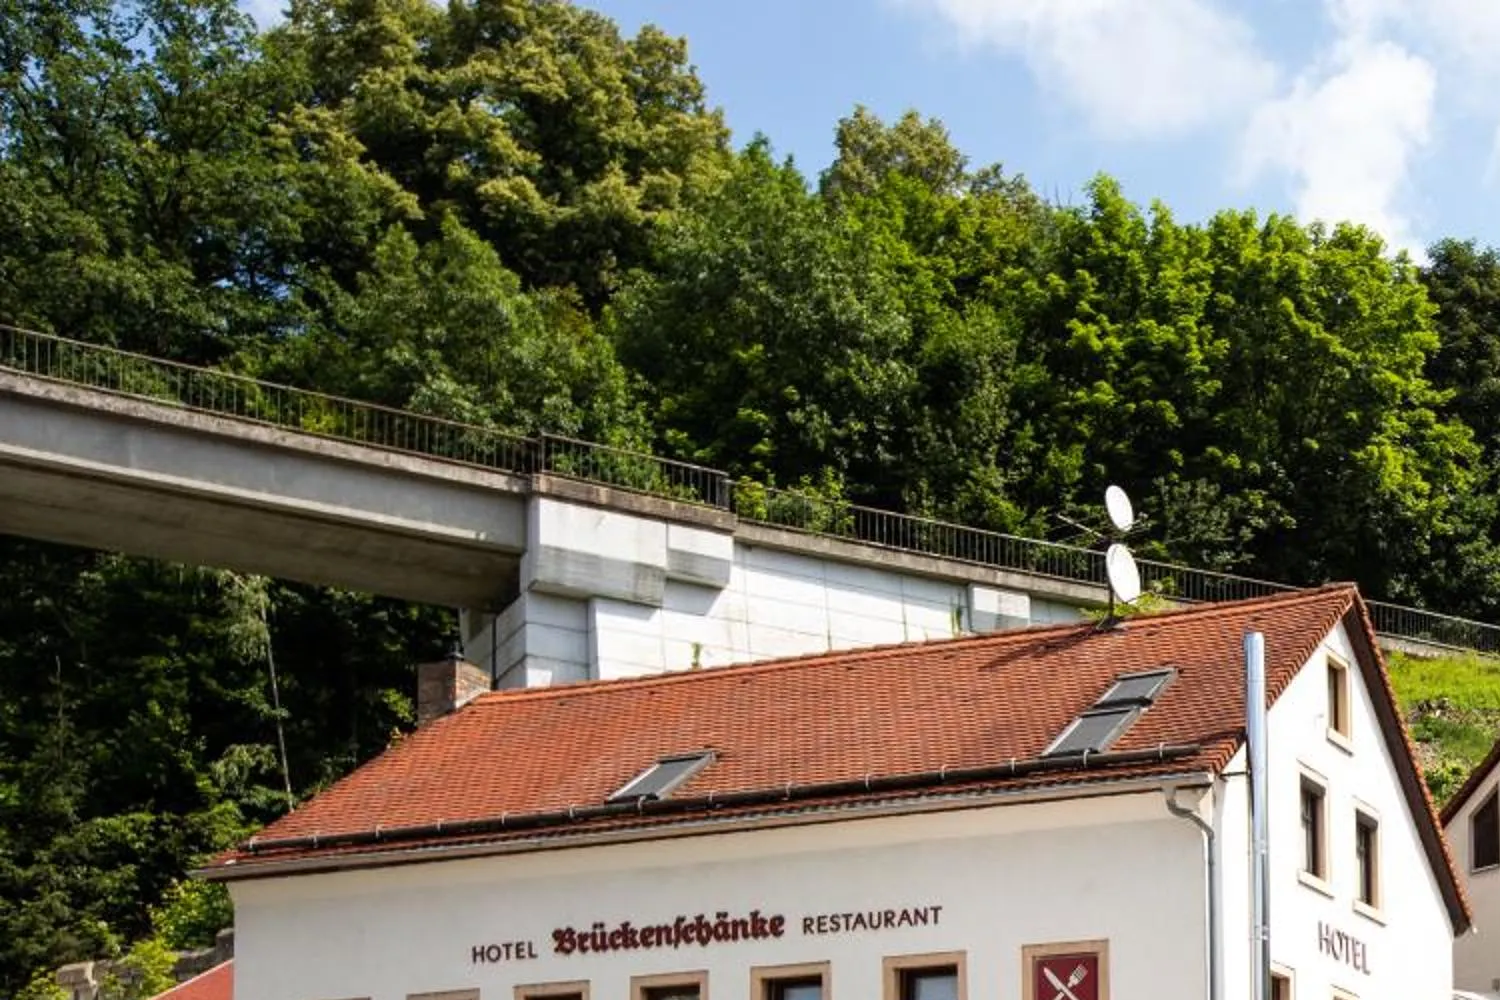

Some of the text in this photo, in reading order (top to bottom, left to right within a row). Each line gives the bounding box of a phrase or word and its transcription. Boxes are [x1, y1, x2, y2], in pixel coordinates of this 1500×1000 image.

[472, 941, 538, 964] HOTEL
[802, 905, 943, 935] RESTAURANT
[1317, 919, 1371, 977] HOTEL
